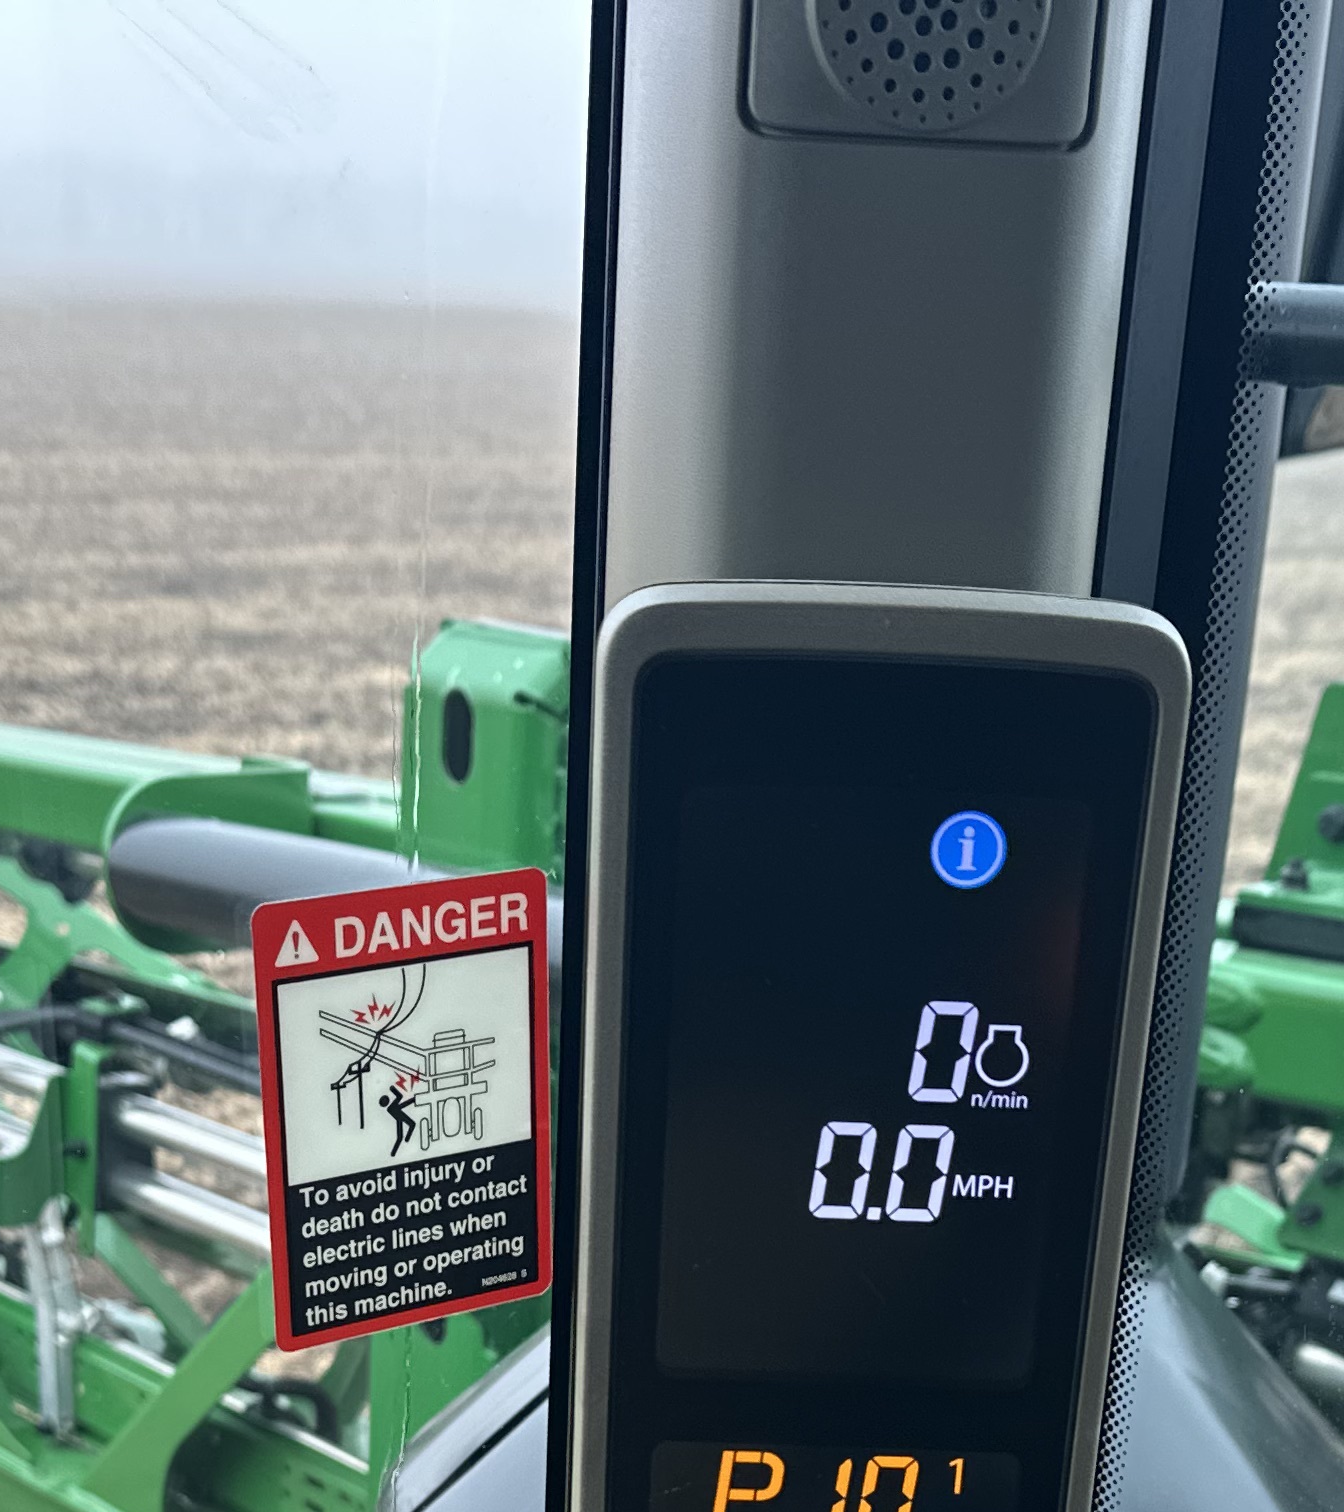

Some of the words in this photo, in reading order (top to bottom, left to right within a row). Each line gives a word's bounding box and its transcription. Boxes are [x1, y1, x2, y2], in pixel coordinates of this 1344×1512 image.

[334, 891, 529, 959] DANGER
[907, 1000, 980, 1103] 0
[970, 1091, 1028, 1109] n/min
[298, 1186, 330, 1208] To
[335, 1169, 397, 1202] avoid
[403, 1160, 466, 1190] injury
[471, 1154, 496, 1174] or
[808, 1121, 955, 1222] 0.0
[952, 1173, 1014, 1199] MPH
[301, 1208, 365, 1239] death
[370, 1202, 400, 1225] do
[405, 1192, 442, 1218] not
[447, 1174, 528, 1208] contact
[302, 1234, 386, 1268] electric
[392, 1223, 444, 1250] lines
[449, 1210, 507, 1237] when
[305, 1264, 388, 1298] moving
[393, 1258, 418, 1278] or
[422, 1235, 525, 1273] operating
[305, 1302, 349, 1327] this
[354, 1280, 454, 1316] machine.
[948, 1457, 965, 1495] 1
